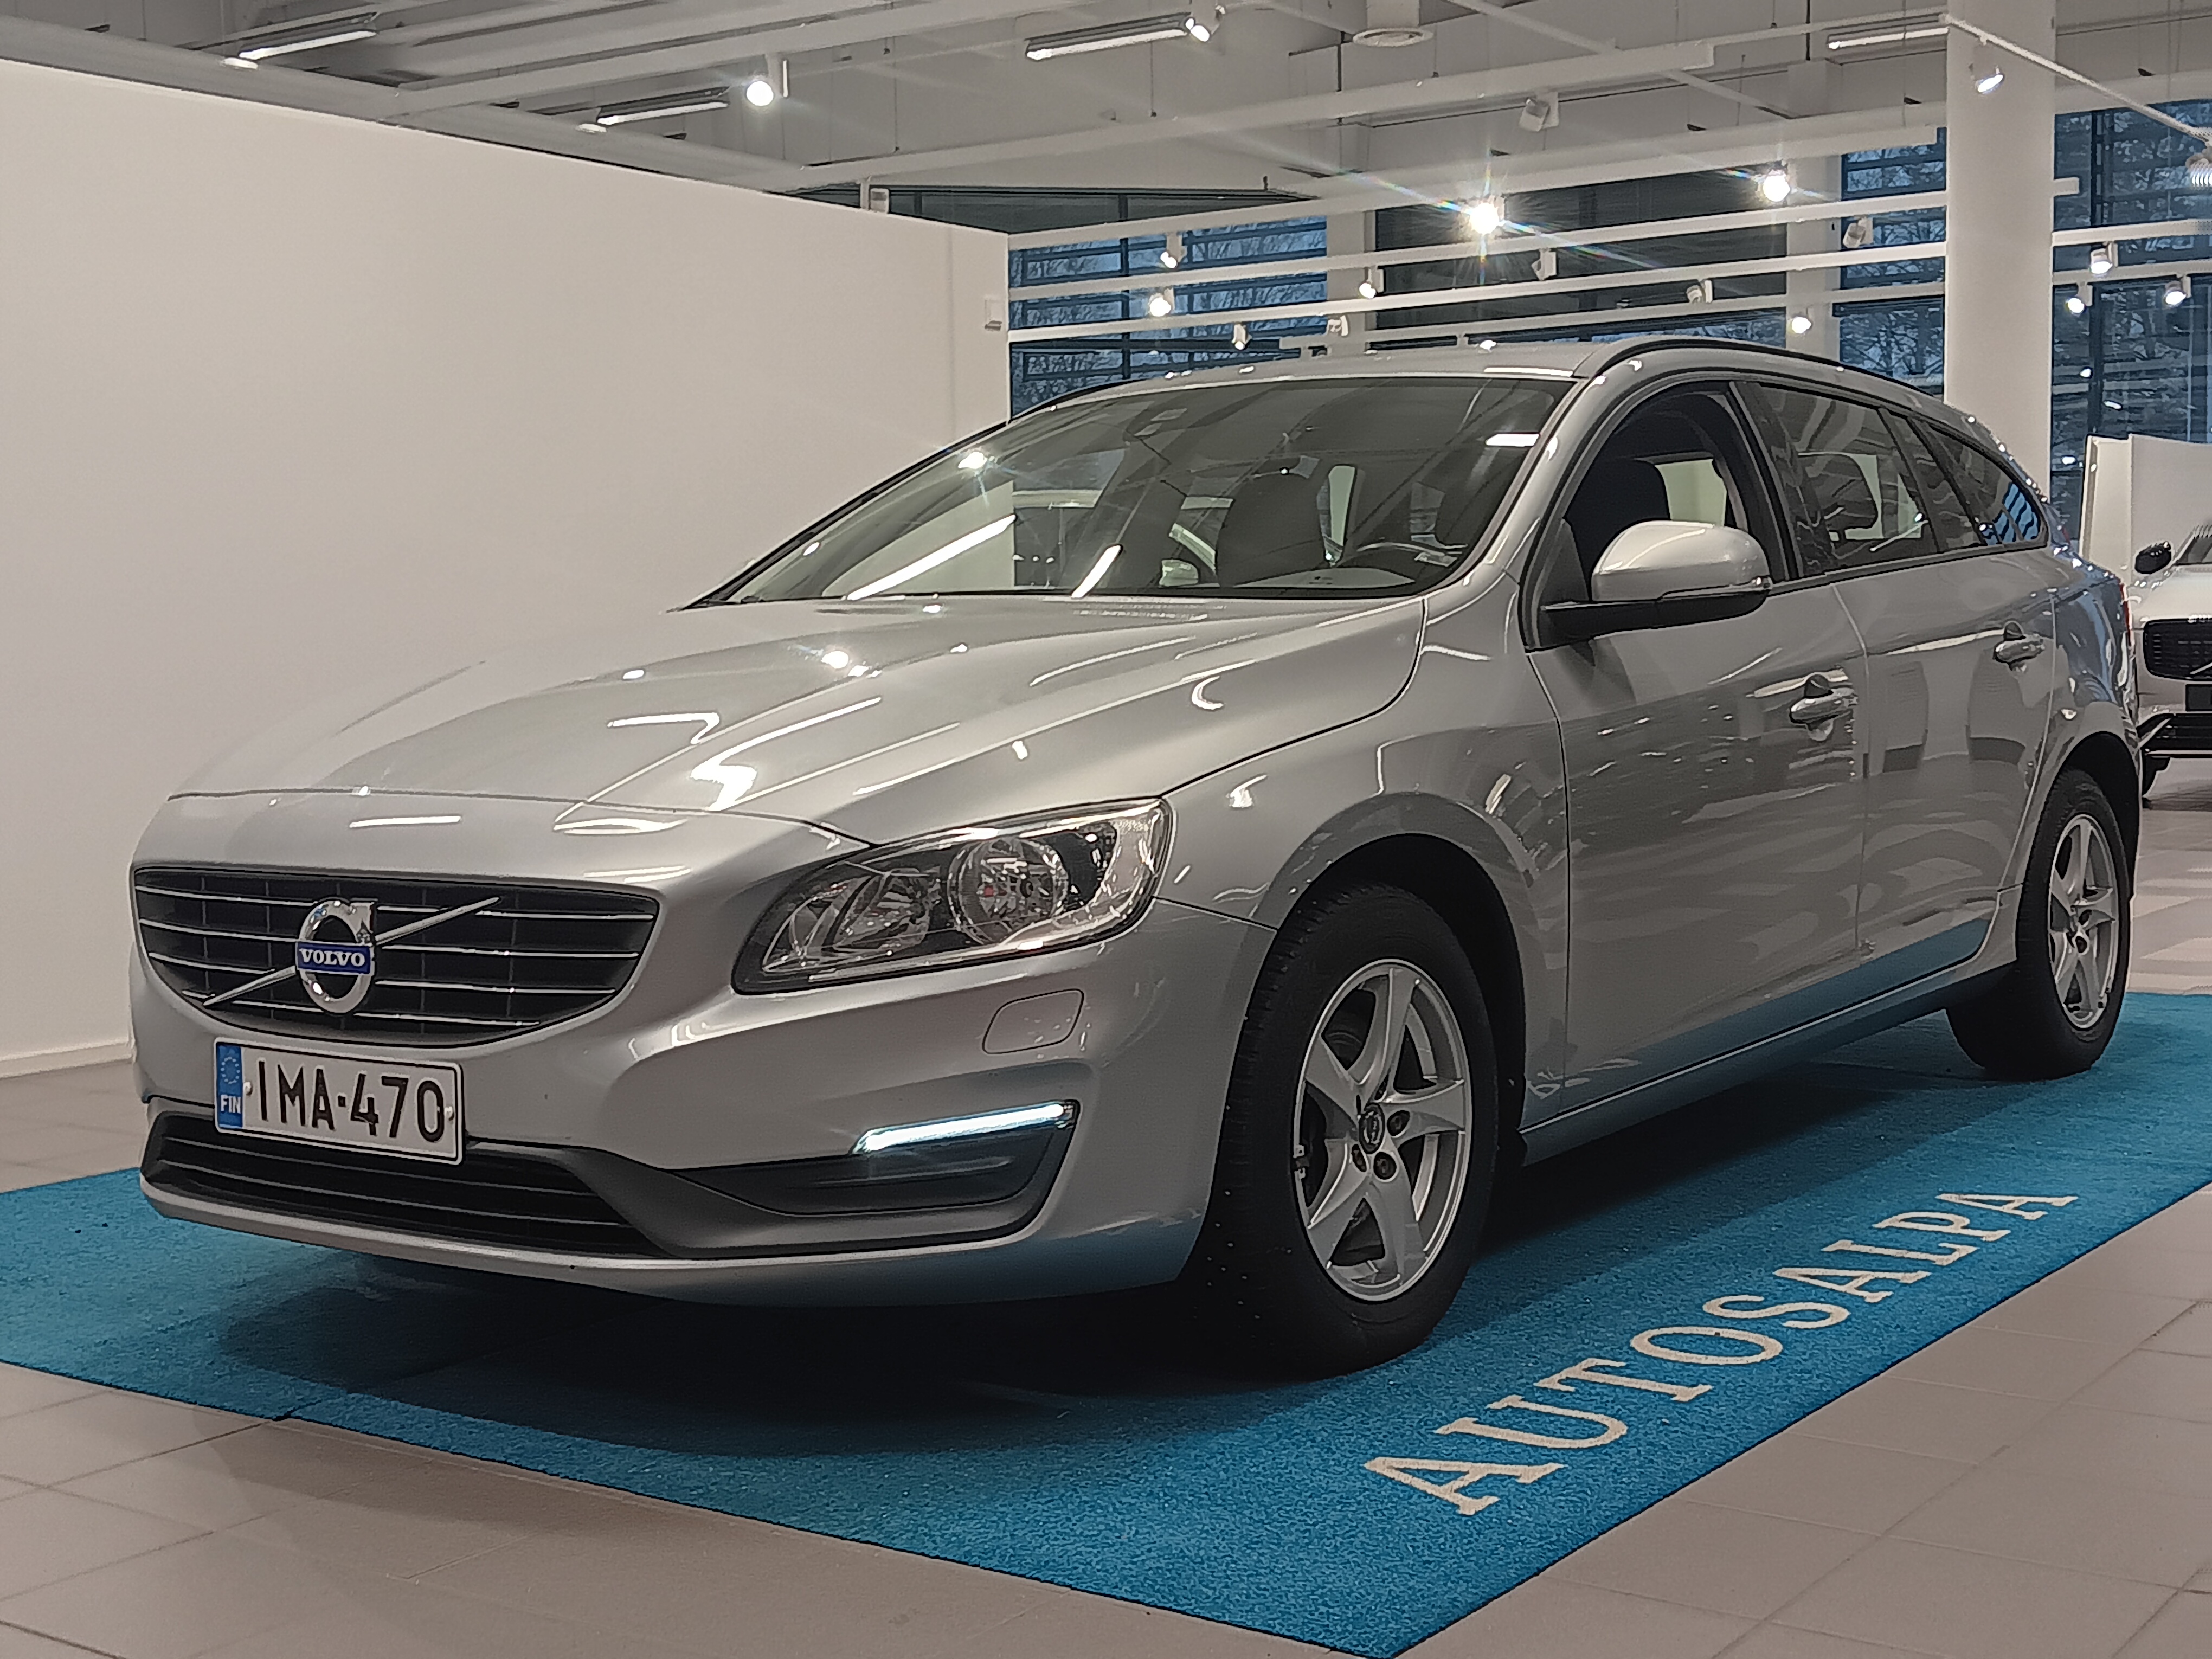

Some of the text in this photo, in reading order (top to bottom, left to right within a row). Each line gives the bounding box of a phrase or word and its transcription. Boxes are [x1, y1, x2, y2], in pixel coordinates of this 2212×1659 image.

[299, 948, 365, 967] VOLVO
[220, 1095, 241, 1114] FIN
[258, 1060, 445, 1142] IMA-470
[1364, 1192, 2079, 1516] AUTOSALPA
